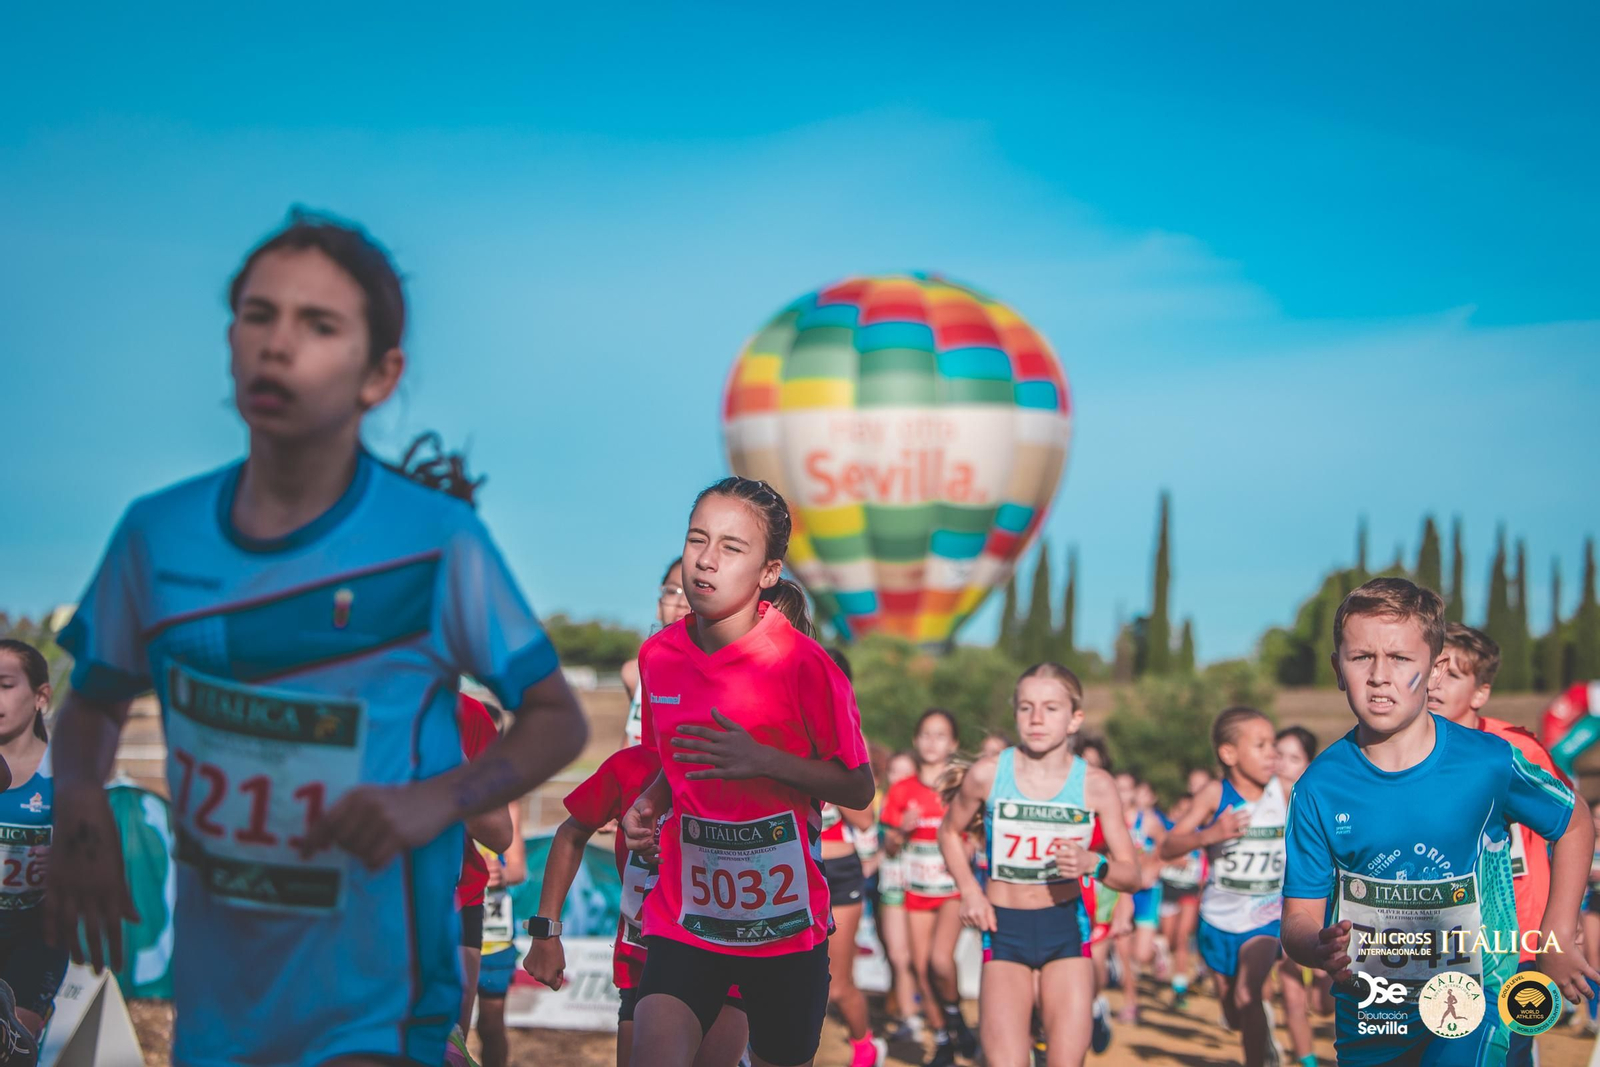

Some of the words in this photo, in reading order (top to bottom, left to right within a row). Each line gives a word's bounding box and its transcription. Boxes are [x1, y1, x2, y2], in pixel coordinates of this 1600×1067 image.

[650, 692, 681, 705] hummel
[174, 747, 327, 850] 7211
[704, 824, 763, 843] ITÁLICA
[737, 846, 777, 857] MAZARIEGOS
[1223, 849, 1284, 874] 5776
[1367, 852, 1387, 871] CLUB
[691, 863, 799, 910] 5032
[1375, 885, 1443, 901] ITÁLICA
